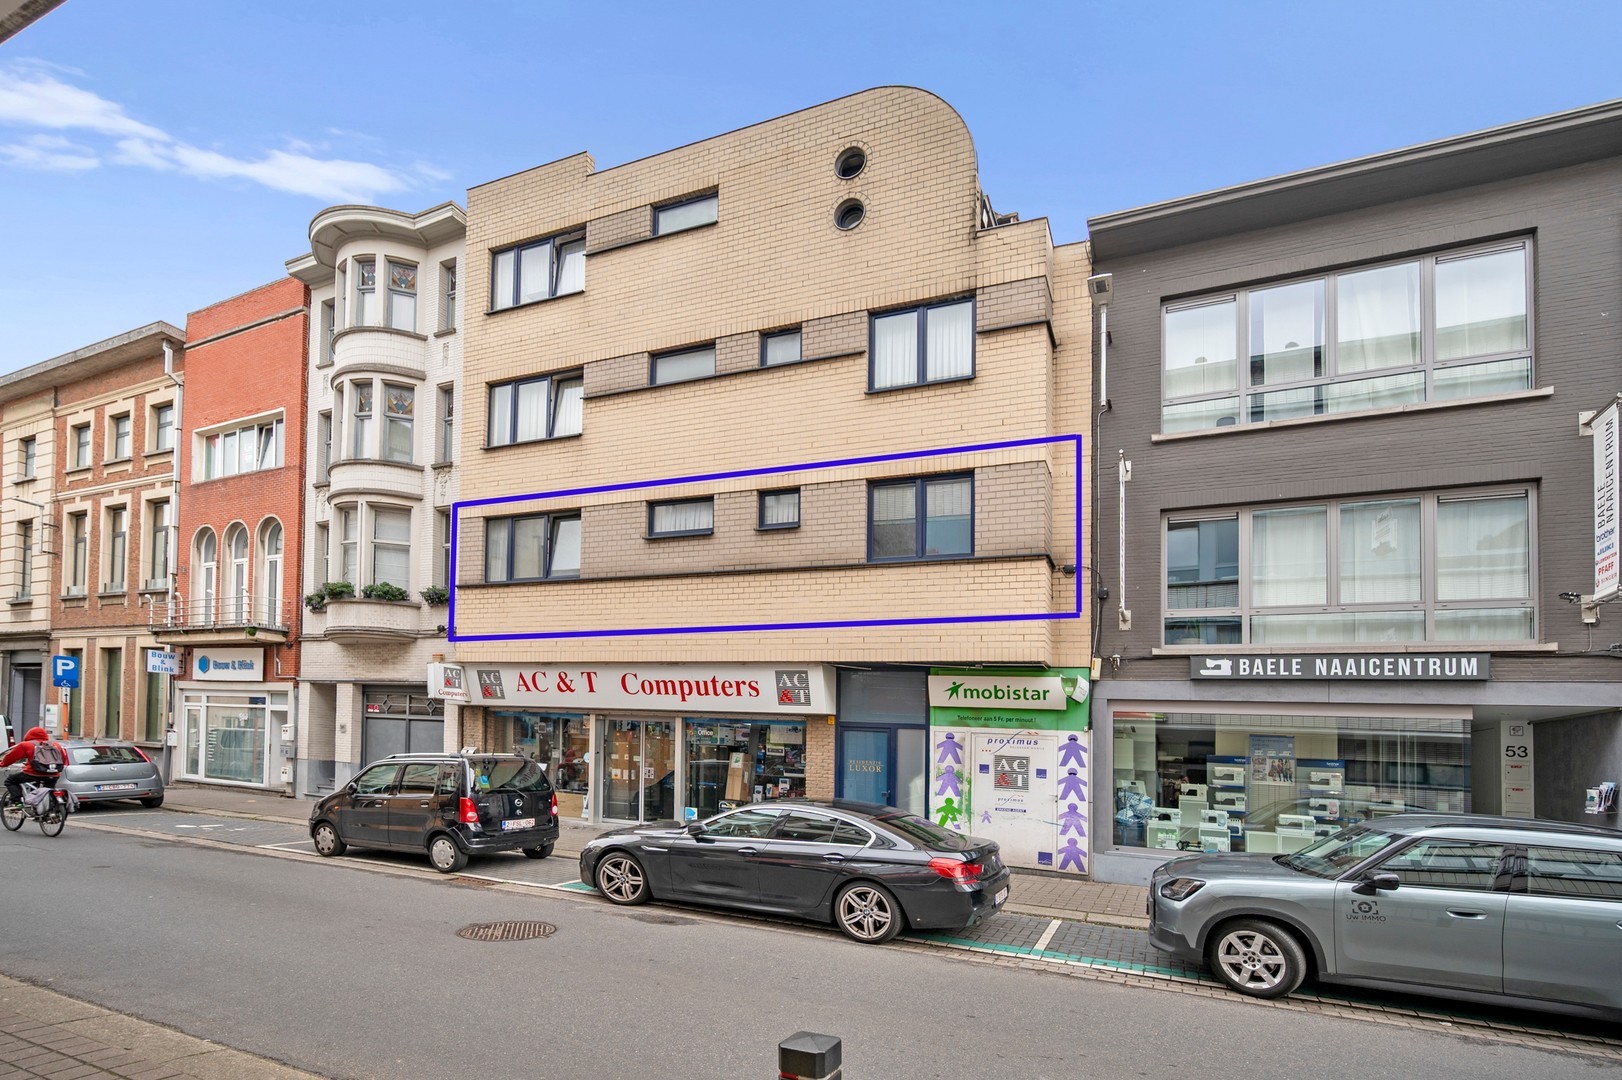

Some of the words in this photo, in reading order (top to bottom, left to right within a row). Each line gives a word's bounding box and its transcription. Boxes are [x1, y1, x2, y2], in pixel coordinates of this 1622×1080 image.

[1605, 418, 1614, 524] NAAICENTRUM
[1597, 543, 1614, 556] JUKI
[1598, 561, 1614, 576] PFAFF
[1601, 573, 1617, 584] SINGER
[151, 651, 176, 660] Bouw
[56, 659, 75, 676] P
[151, 665, 175, 673] Blink
[213, 660, 230, 670] Bouw
[231, 660, 237, 670] &
[238, 660, 254, 670] Blink
[1239, 658, 1302, 676] BAELE
[1315, 657, 1478, 676] NAAICENTRUM
[444, 669, 460, 678] AC
[480, 672, 500, 684] AC
[779, 673, 807, 687] AC
[438, 689, 468, 697] Computers
[517, 671, 549, 693] AC
[556, 671, 576, 693] &
[580, 671, 598, 693] T
[620, 672, 760, 702] Computers
[963, 685, 1050, 701] mobistar
[987, 738, 1039, 746] proximus
[1505, 745, 1528, 758] 53
[849, 765, 882, 773] LUXOR
[997, 758, 1027, 772] AC
